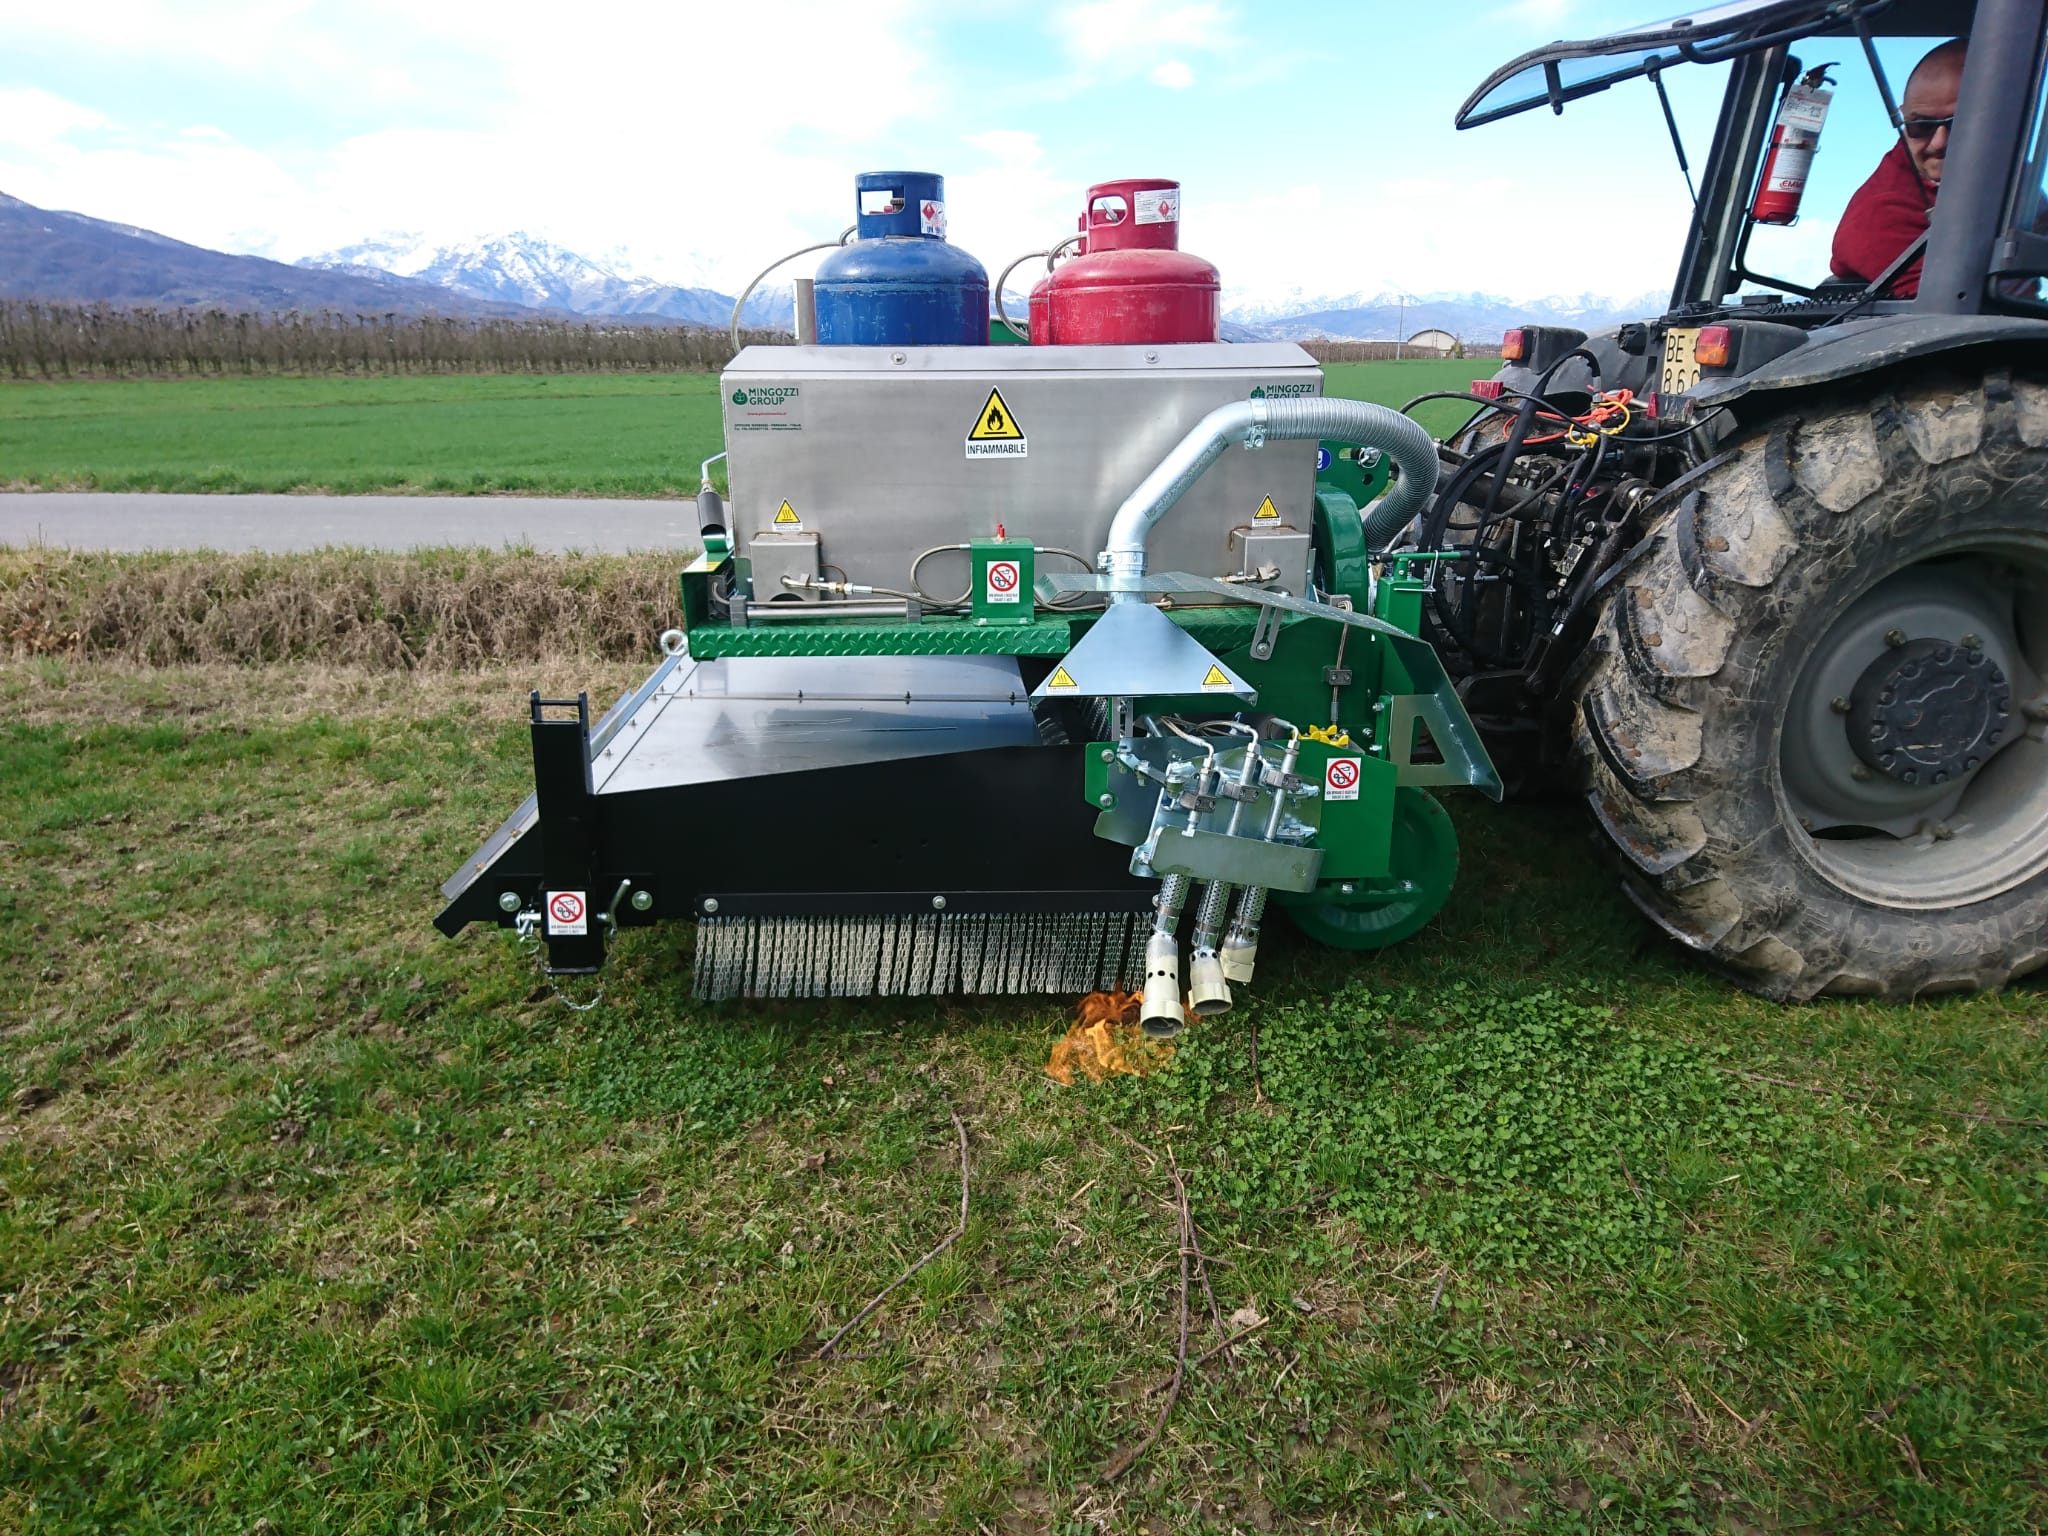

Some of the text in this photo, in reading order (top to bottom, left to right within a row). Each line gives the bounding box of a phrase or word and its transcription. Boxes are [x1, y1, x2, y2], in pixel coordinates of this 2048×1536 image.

[1667, 335, 1685, 363] BE
[749, 388, 799, 396] MINGOZZI
[1266, 384, 1315, 393] MINGOZZI
[749, 397, 785, 405] GROUP
[968, 444, 1026, 455] INFIAMMABILE
